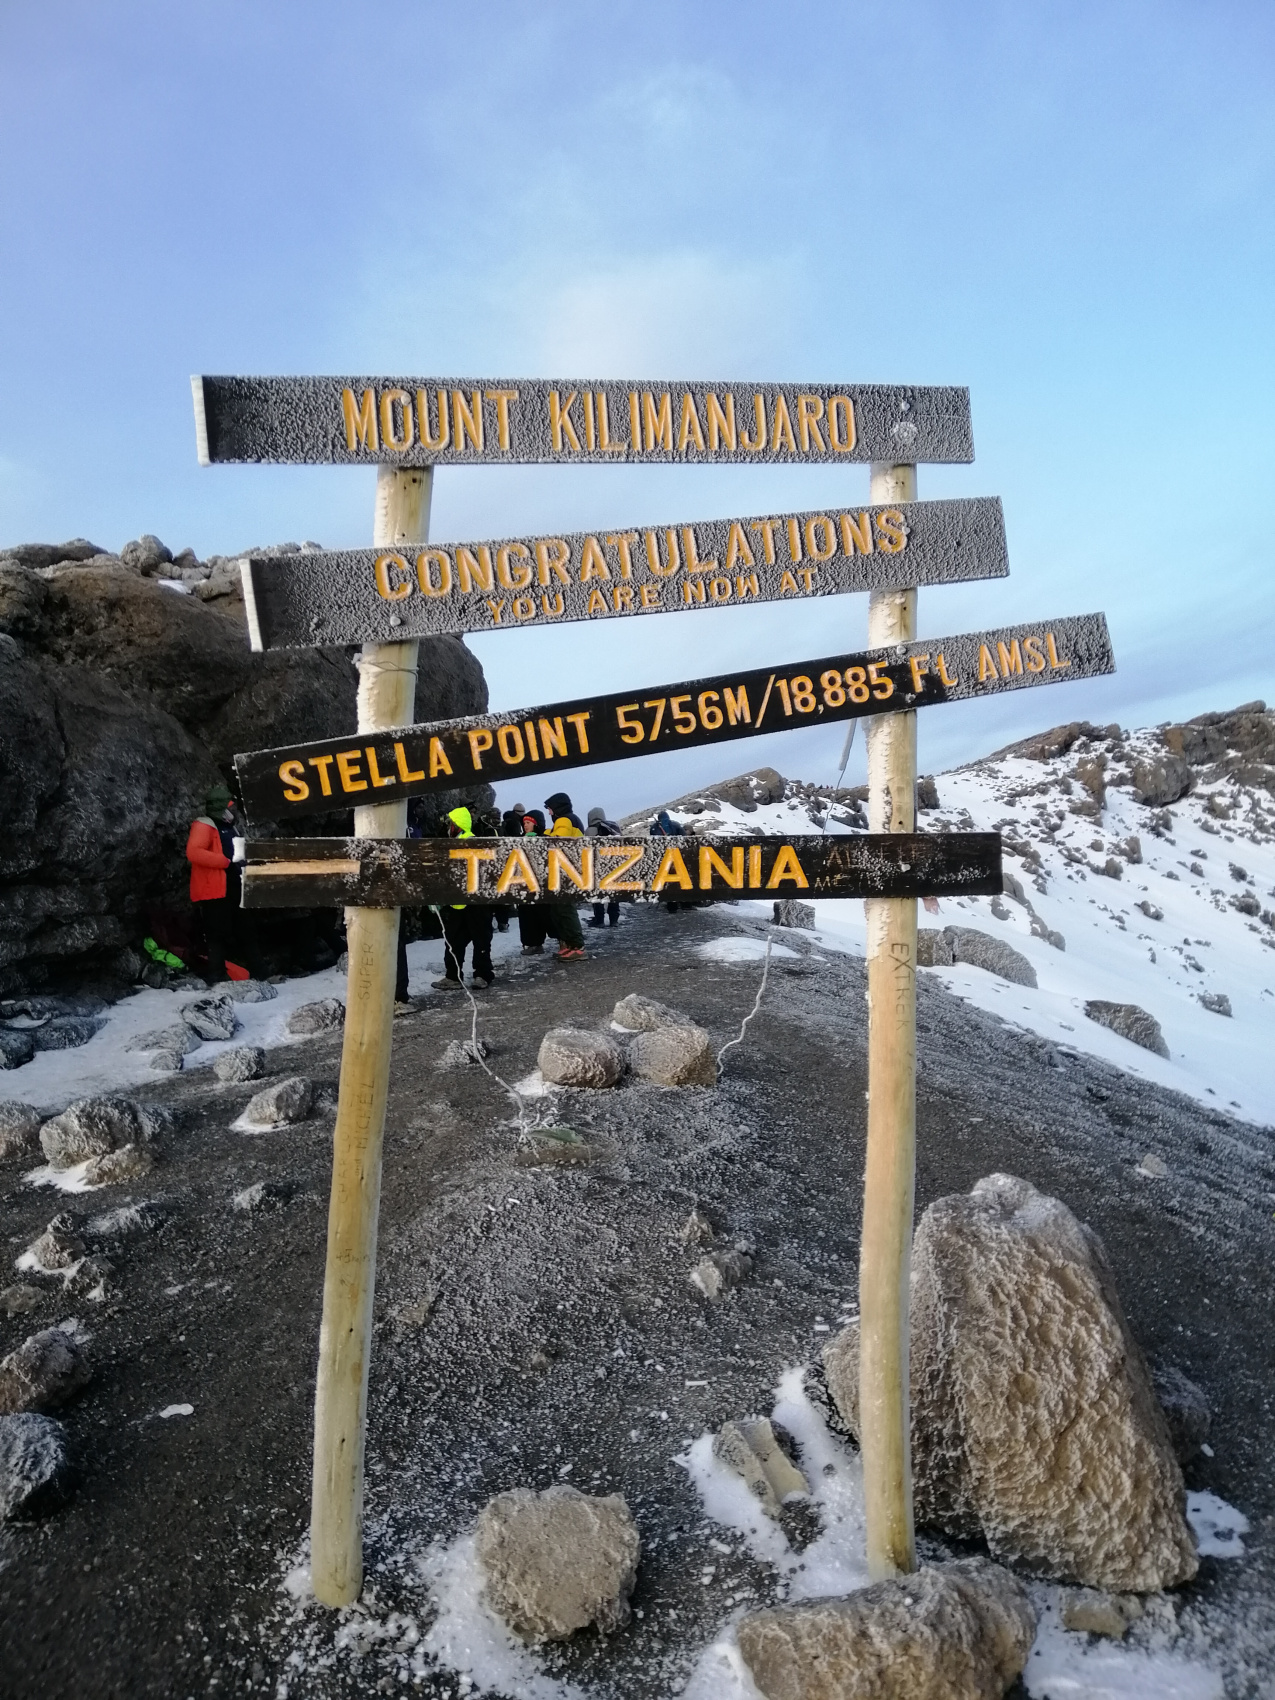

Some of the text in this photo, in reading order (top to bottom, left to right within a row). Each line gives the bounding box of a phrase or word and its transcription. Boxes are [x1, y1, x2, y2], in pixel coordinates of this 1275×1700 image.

[341, 387, 858, 453] MOUNT KILIMANJARO
[374, 509, 907, 601] CONGRATULATIONS
[486, 567, 818, 624] YOU ARE NOW AT
[278, 736, 454, 802] STELLA
[466, 711, 591, 771] POINT
[908, 653, 958, 693] Ft
[977, 633, 1070, 681] AMSL
[448, 844, 810, 894] TANZANIA
[358, 942, 375, 1001] SUPER
